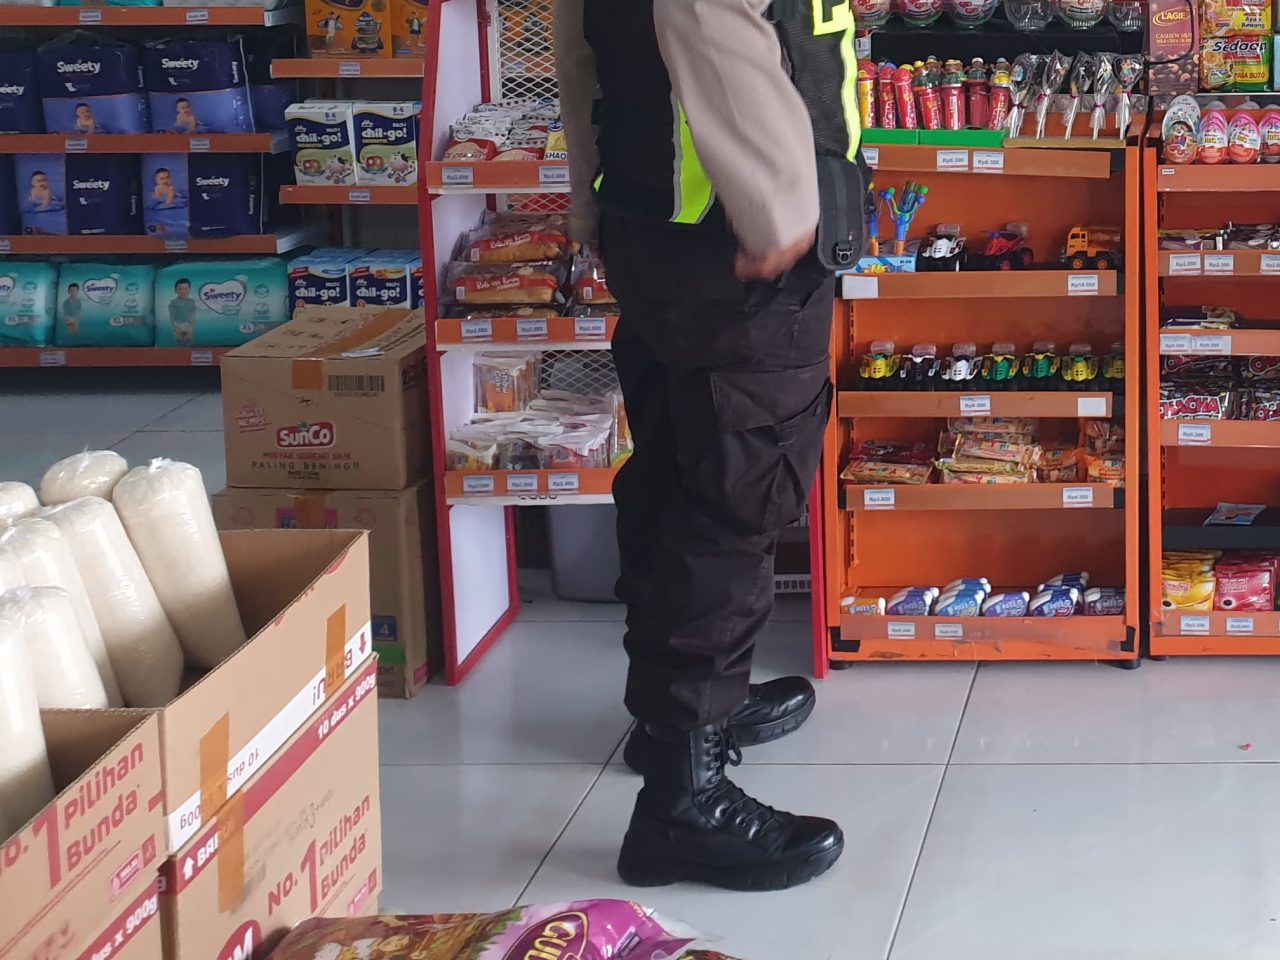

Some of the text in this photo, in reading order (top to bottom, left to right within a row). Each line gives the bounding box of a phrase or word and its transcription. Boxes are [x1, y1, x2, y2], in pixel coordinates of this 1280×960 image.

[57, 60, 101, 74] Sweety
[161, 58, 200, 71] Sweety
[73, 179, 110, 191] Sweety
[196, 176, 231, 188] Sweety
[85, 282, 116, 294] Sweety
[203, 289, 243, 302] Sweety
[280, 426, 330, 446] SunCo
[252, 462, 294, 470] PALING
[317, 722, 330, 739] 10
[330, 703, 347, 726] dus
[355, 672, 376, 698] 900g
[64, 742, 145, 830] Pilihan
[66, 786, 138, 873] Bunda
[319, 794, 371, 863] Pilihan
[33, 801, 61, 890] 1
[301, 839, 318, 914] 1
[321, 832, 367, 900] Bunda
[125, 897, 158, 942] 900g
